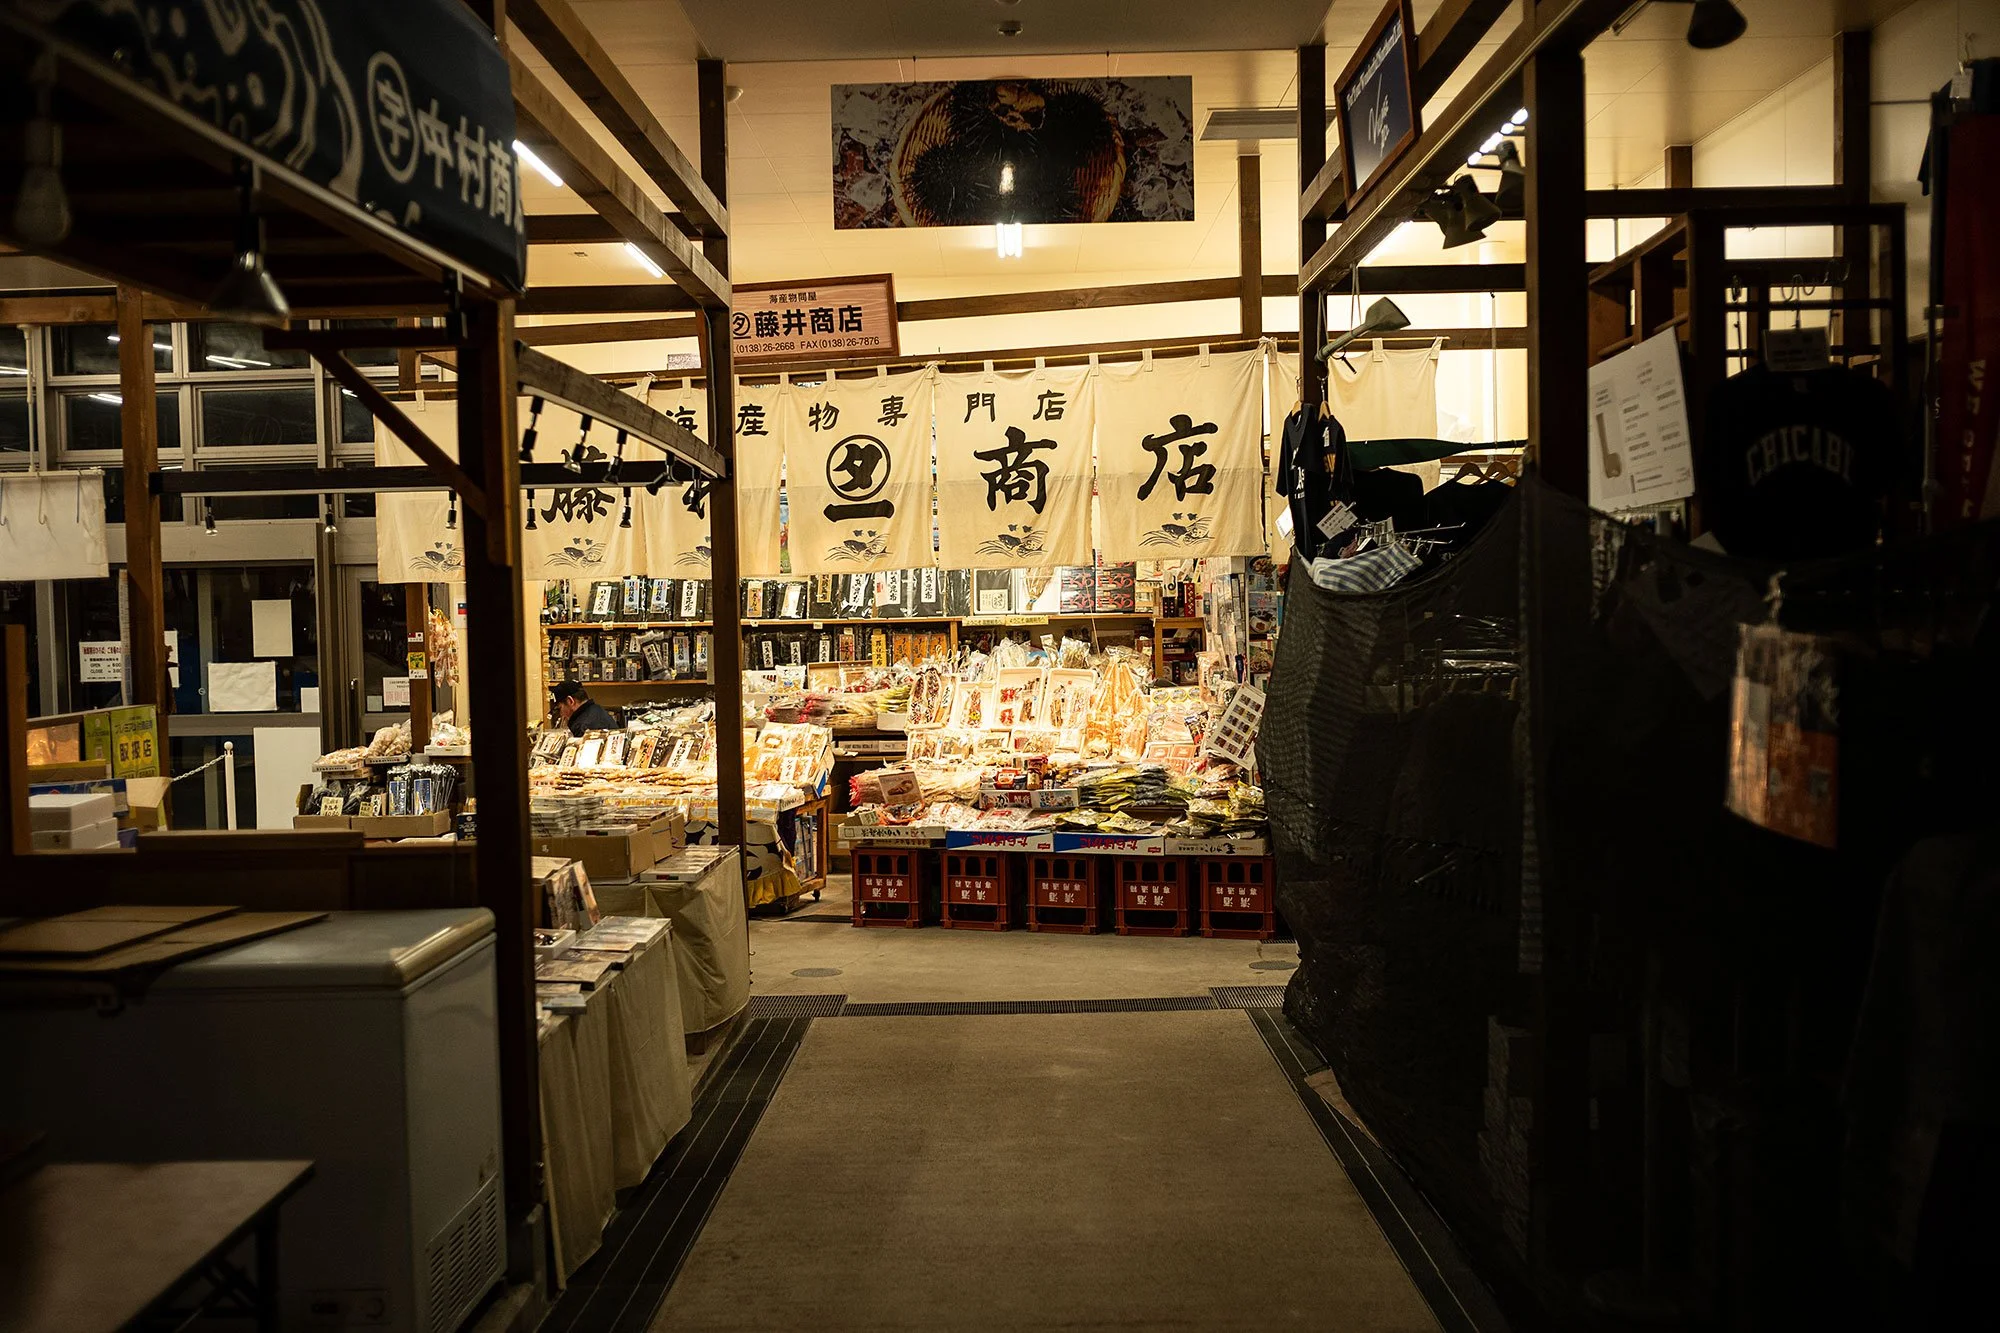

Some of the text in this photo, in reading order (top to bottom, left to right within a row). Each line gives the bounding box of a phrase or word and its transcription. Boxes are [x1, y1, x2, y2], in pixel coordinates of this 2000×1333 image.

[416, 97, 524, 234] 中村商
[753, 305, 863, 338] 藤井商店
